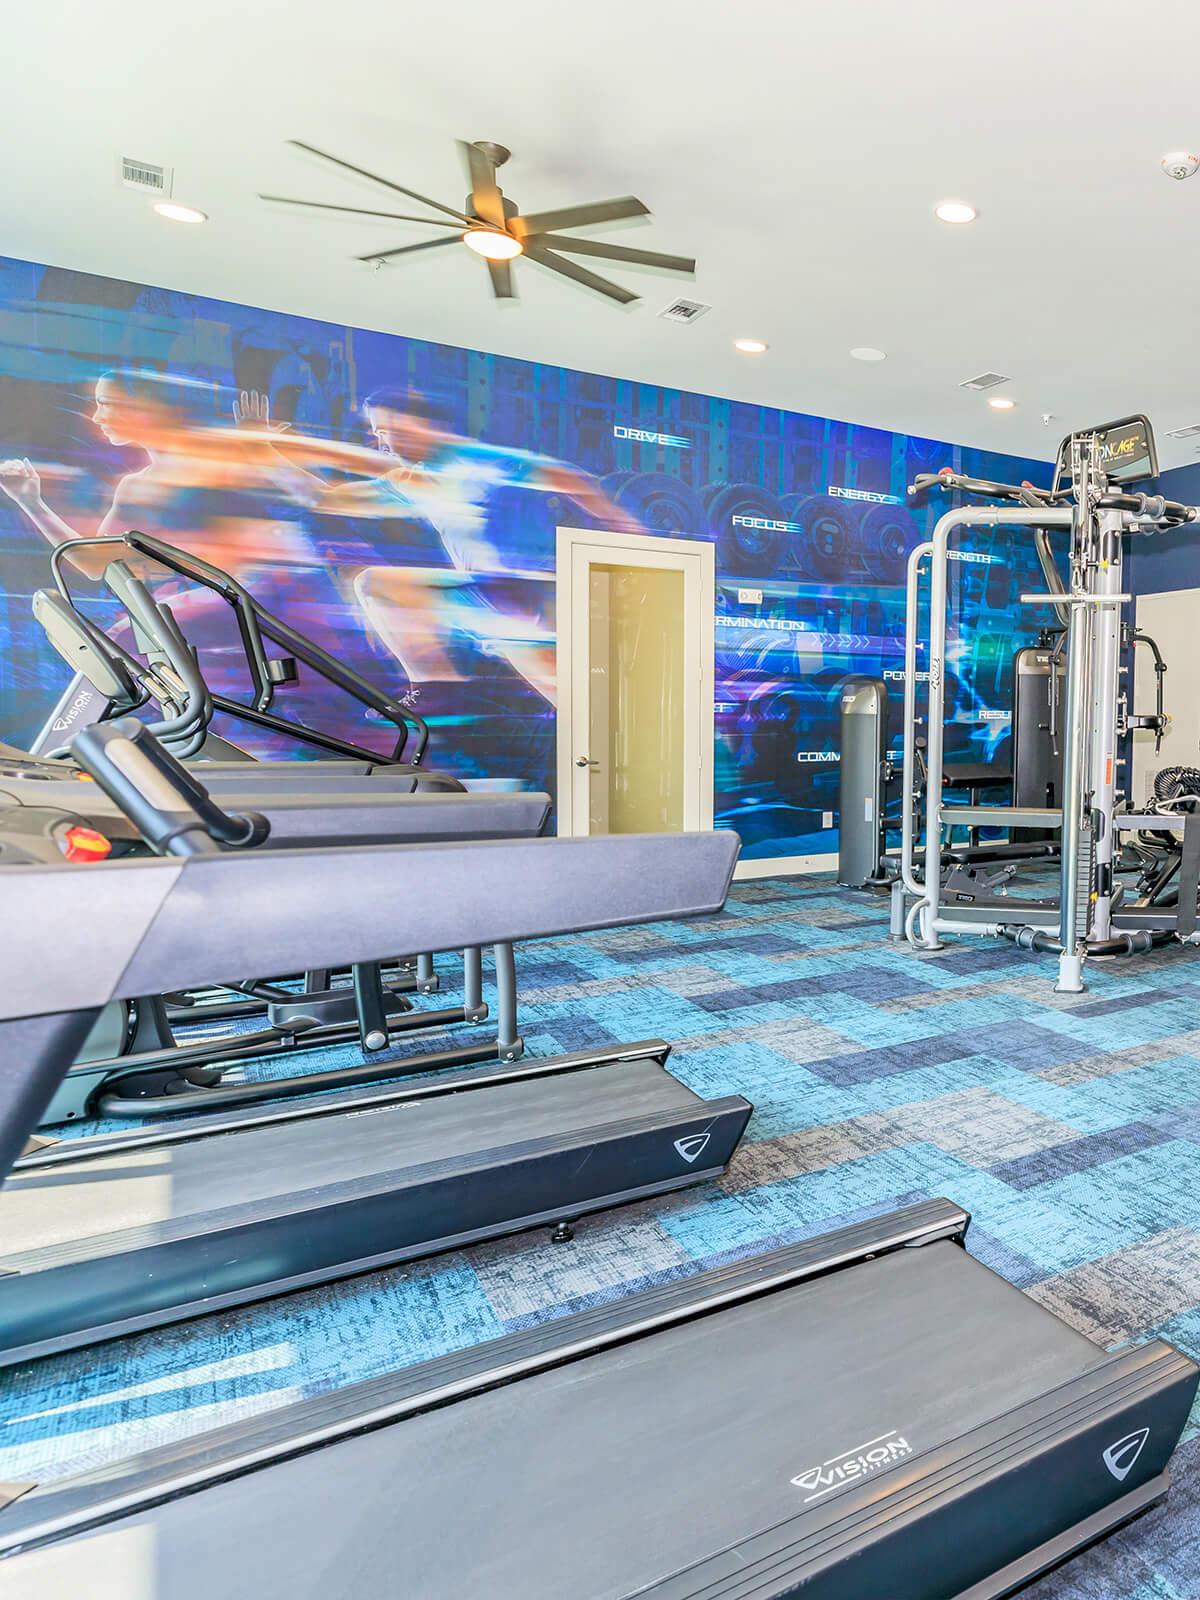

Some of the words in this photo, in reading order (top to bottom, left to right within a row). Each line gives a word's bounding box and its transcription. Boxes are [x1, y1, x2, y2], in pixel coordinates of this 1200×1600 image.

[613, 424, 676, 448] DRIVE
[828, 486, 892, 504] ENERGY
[732, 515, 793, 532] FOCUS
[714, 616, 806, 631] RMINATION
[64, 690, 90, 725] VISION
[819, 1437, 910, 1485] VISION
[862, 1446, 913, 1475] FITNESS
